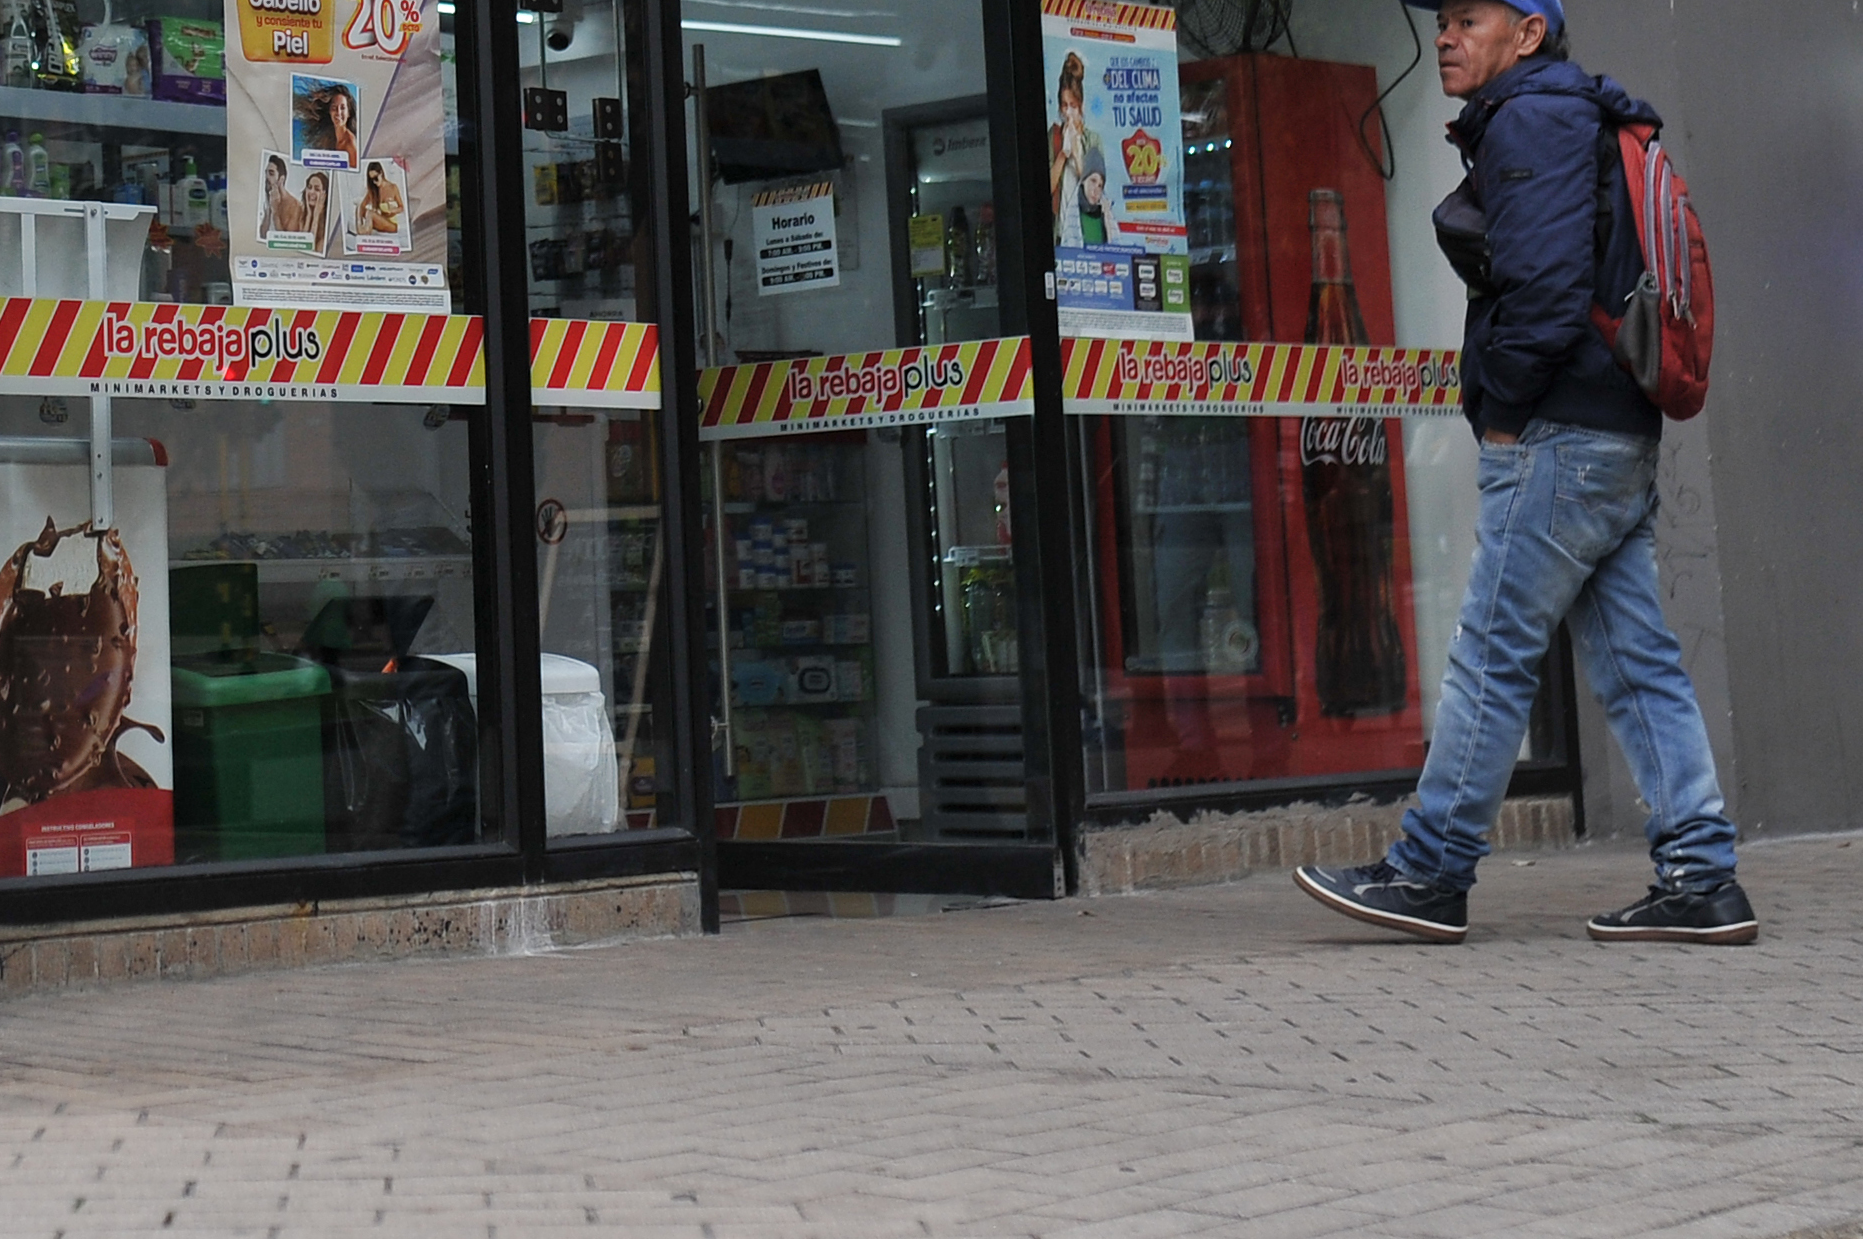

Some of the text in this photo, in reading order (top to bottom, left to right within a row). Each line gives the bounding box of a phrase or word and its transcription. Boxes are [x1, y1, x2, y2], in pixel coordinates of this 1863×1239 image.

[256, 17, 262, 27] y
[312, 18, 322, 29] tu
[273, 30, 308, 55] Piel
[1111, 71, 1159, 89] DEL CLIMA
[1113, 92, 1158, 103] no afecten
[1112, 107, 1162, 127] TU SALUD
[772, 213, 815, 230] Horario
[107, 315, 320, 370] la rebaja plus
[790, 355, 963, 405] la rebaja plus
[1120, 350, 1252, 393] la rebaja plus
[1342, 356, 1458, 398] la rebaja plus
[90, 382, 211, 395] MINIMARKETS
[232, 385, 338, 399] DROGUERIAS
[780, 416, 873, 432] MINIMARKETS
[889, 407, 980, 423] DROGUERIAS
